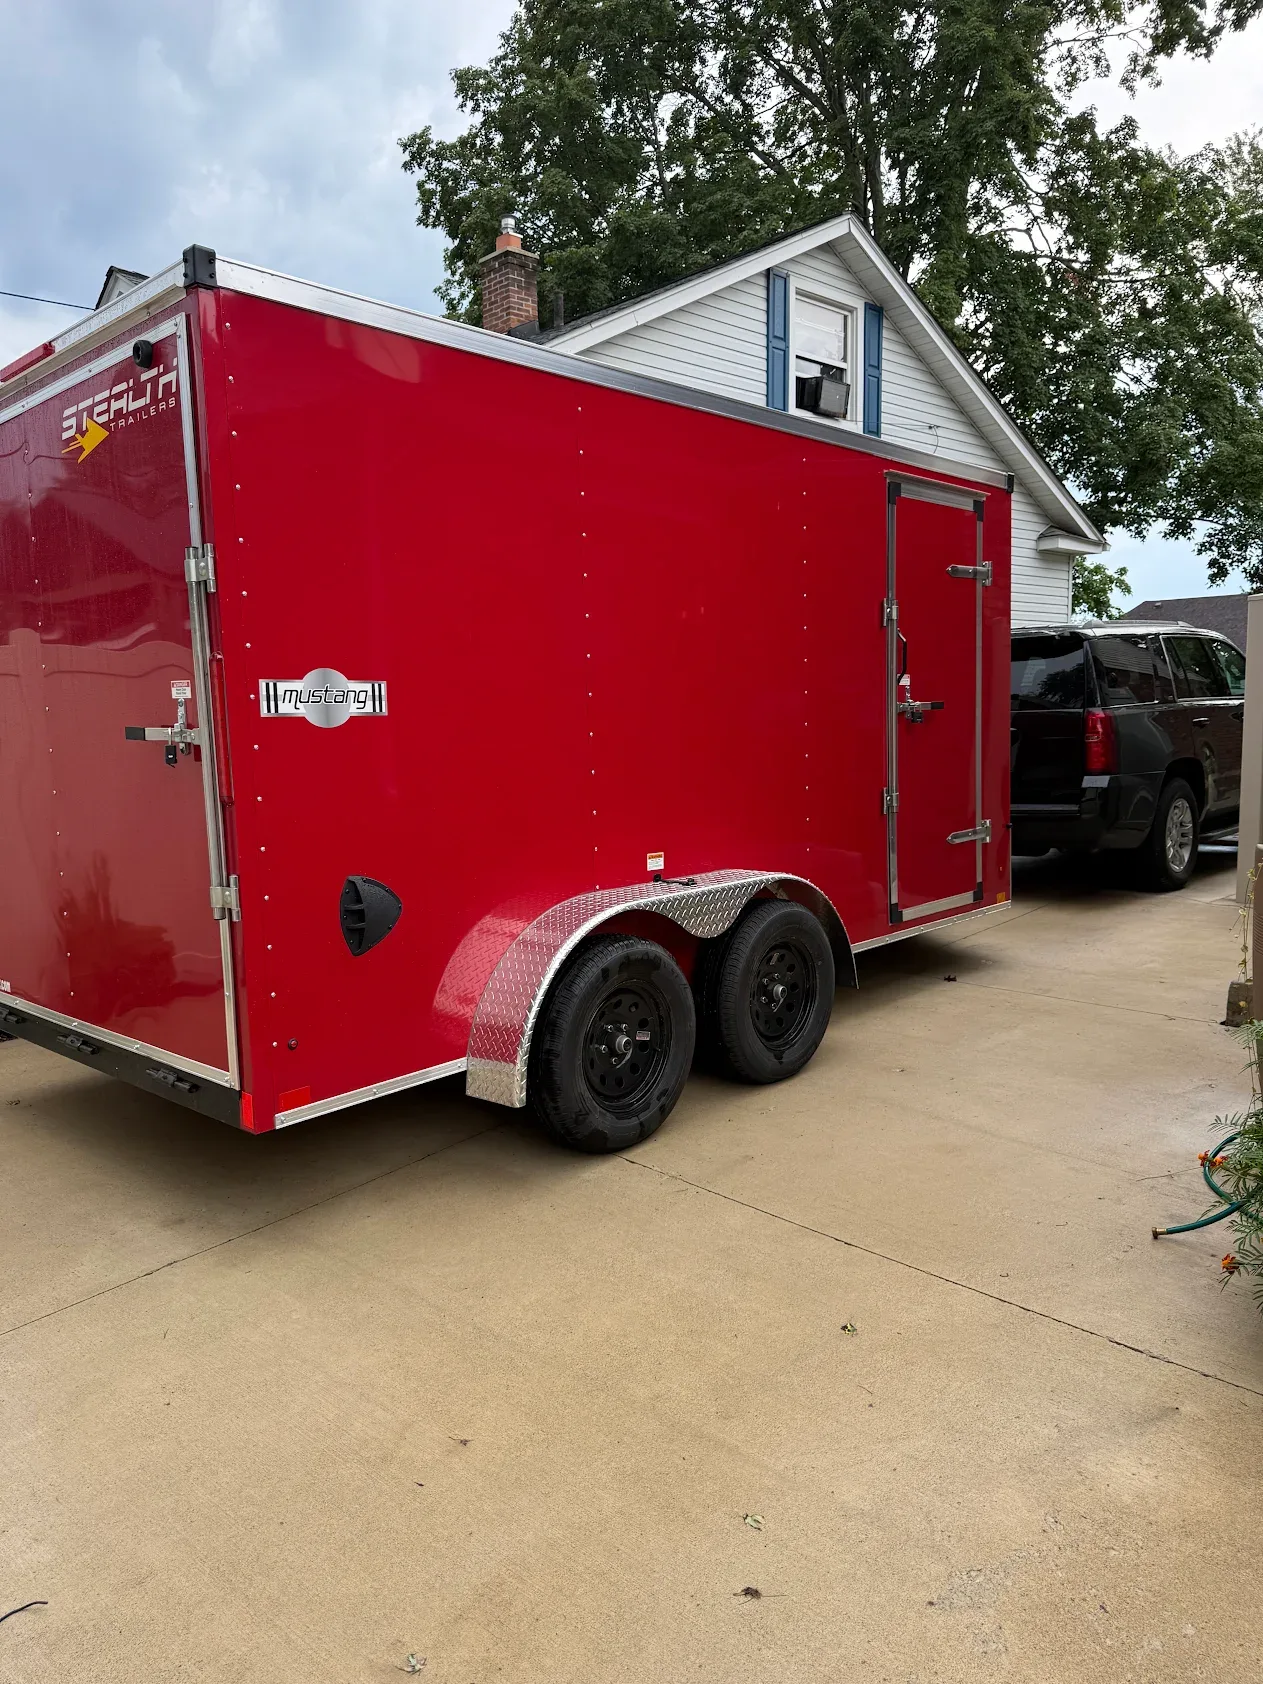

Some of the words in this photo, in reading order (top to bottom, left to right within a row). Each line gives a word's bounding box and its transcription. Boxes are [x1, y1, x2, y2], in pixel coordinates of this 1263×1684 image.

[61, 357, 178, 441] STEALTH
[109, 396, 176, 432] TRAILERS
[282, 684, 369, 710] mustang
